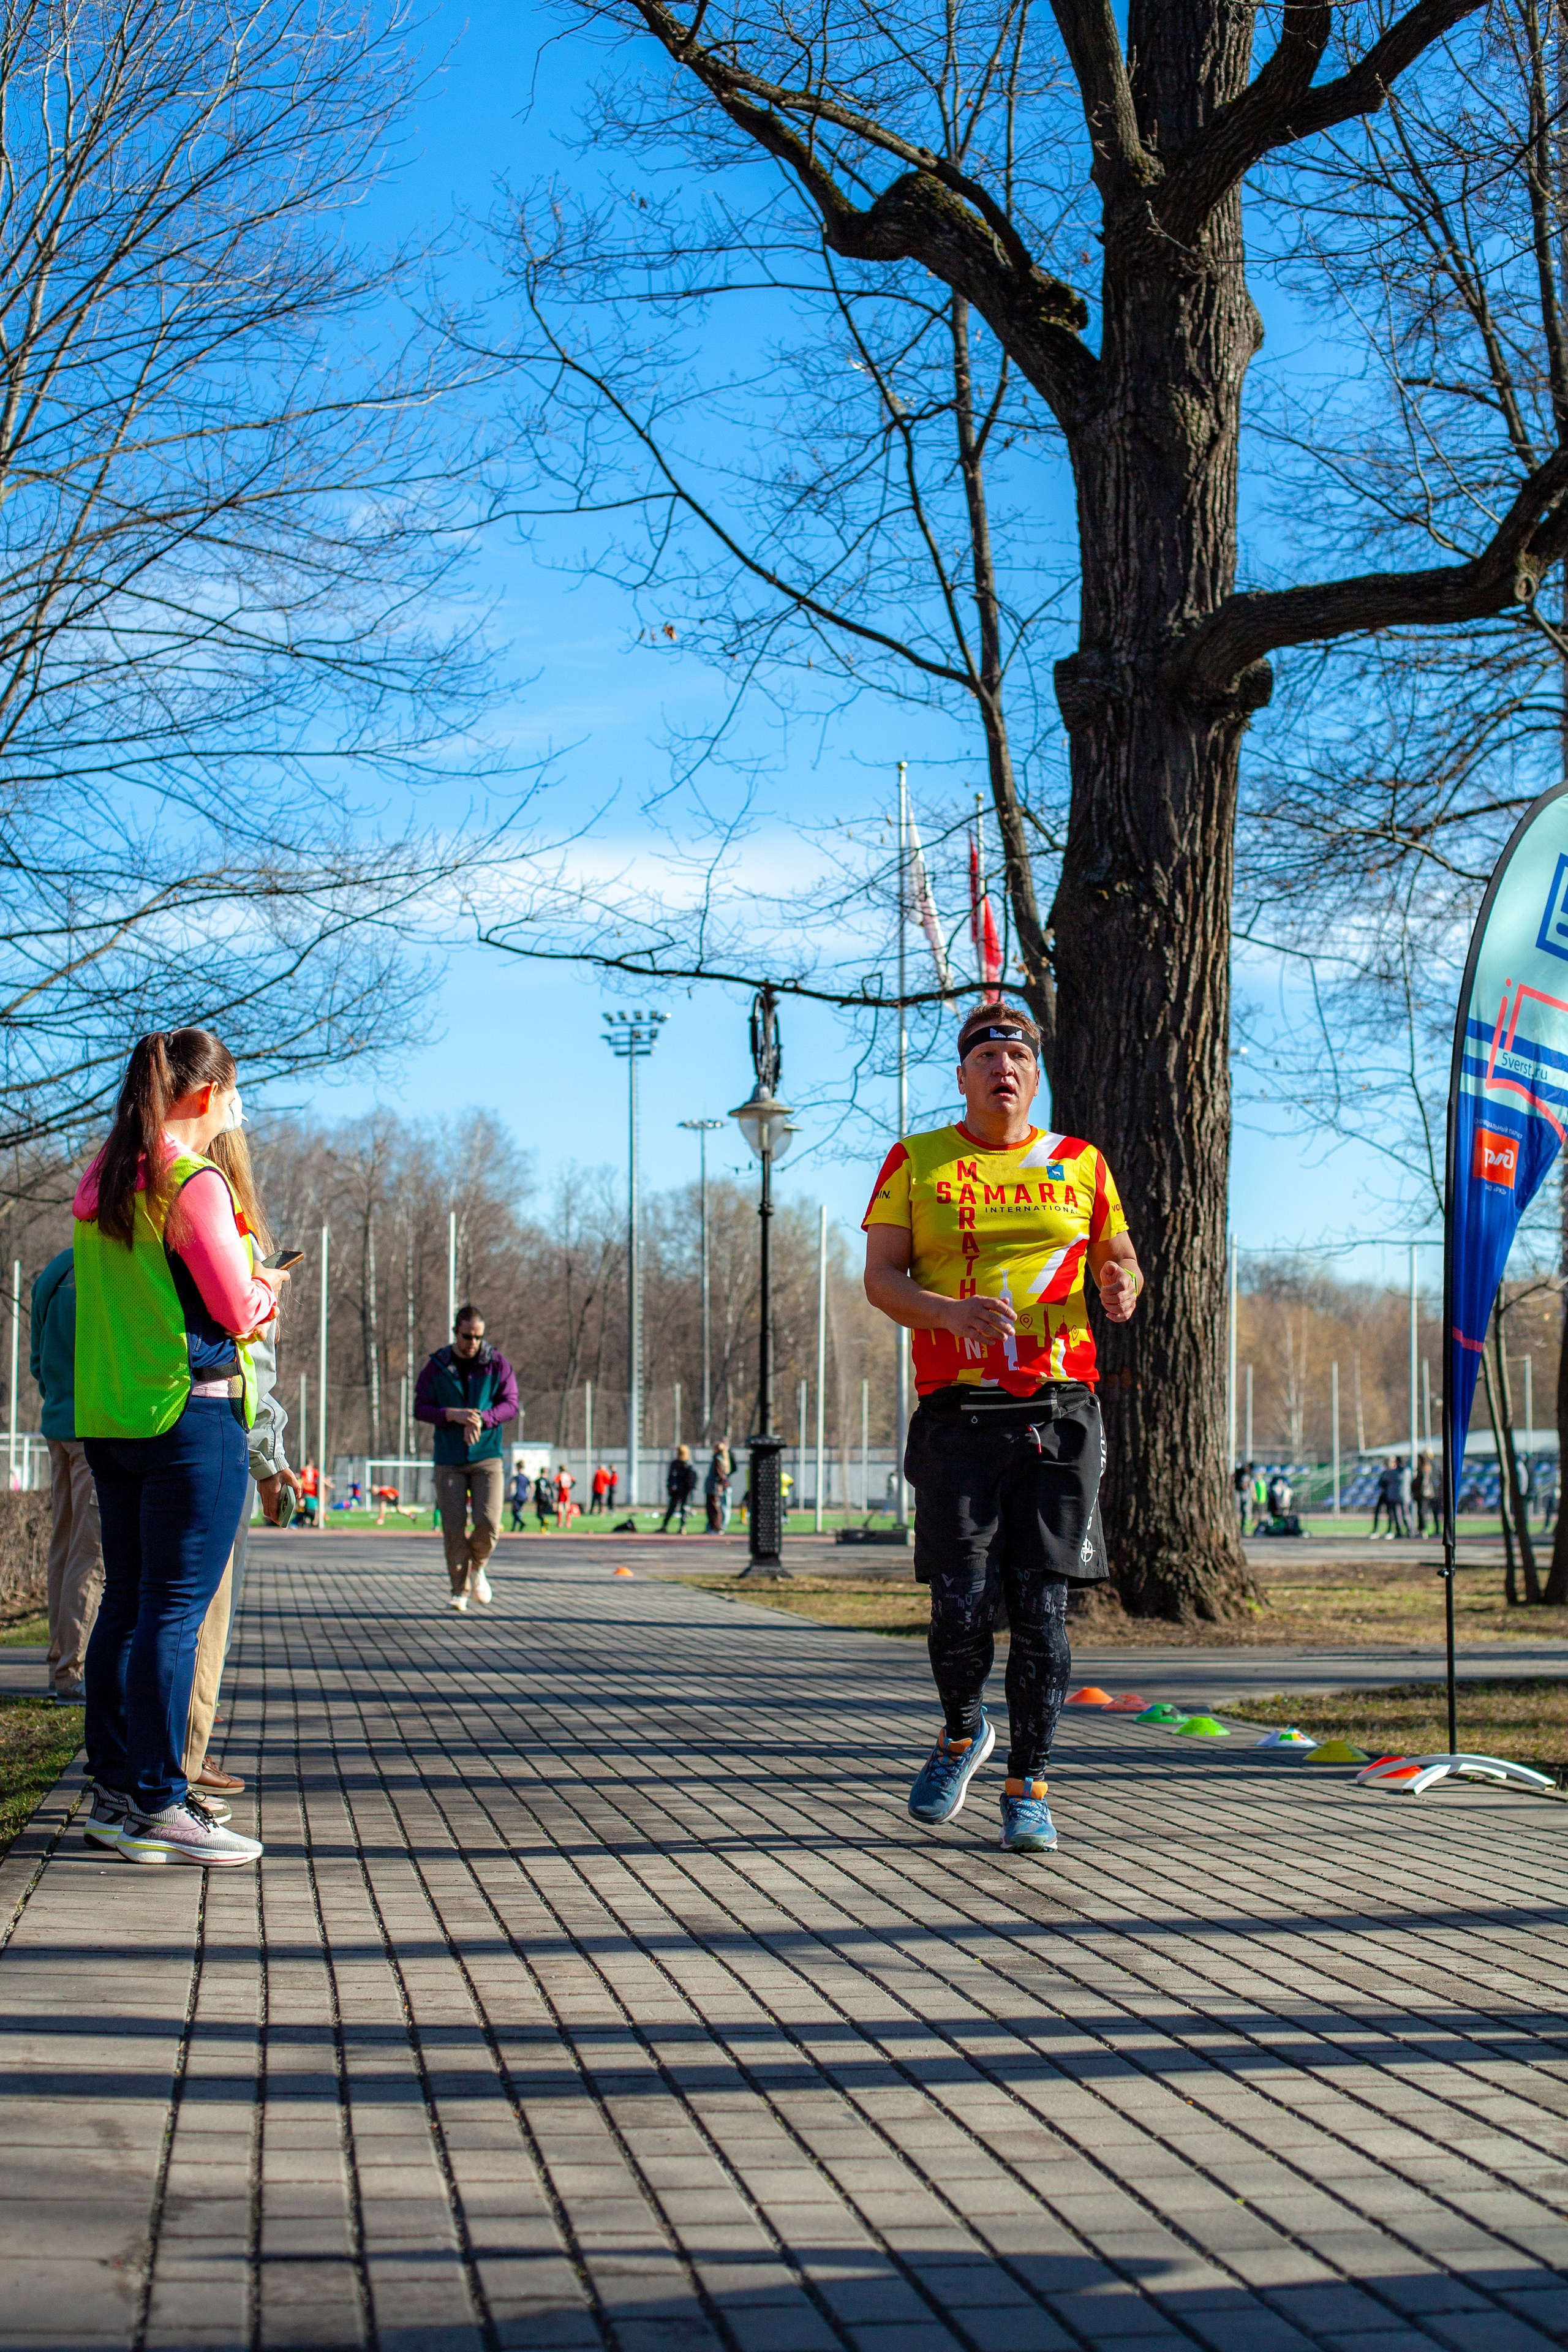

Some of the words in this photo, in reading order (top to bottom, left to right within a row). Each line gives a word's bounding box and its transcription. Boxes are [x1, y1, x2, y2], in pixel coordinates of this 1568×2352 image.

[1501, 1052, 1548, 1080] 5verst.ru
[936, 1181, 1079, 1208] SAMARA
[985, 1205, 1081, 1215] INTERNATIONAL
[957, 1159, 982, 1360] MARATHN
